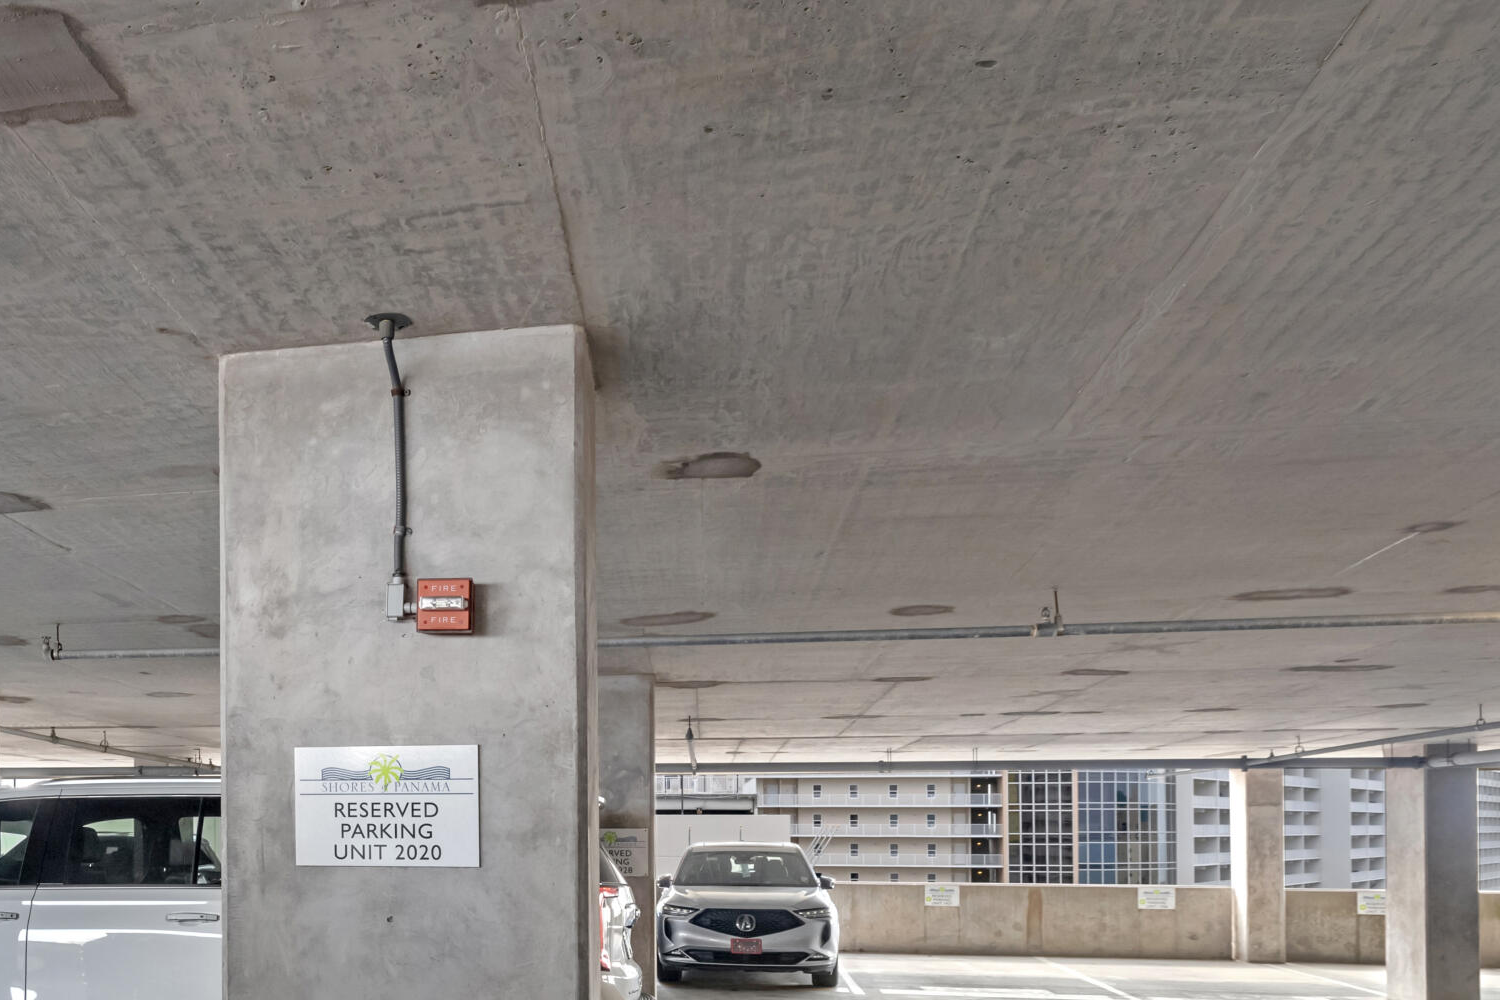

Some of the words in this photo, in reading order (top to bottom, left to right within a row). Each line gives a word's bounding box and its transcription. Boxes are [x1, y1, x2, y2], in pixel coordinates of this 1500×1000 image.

[321, 782, 375, 793] SHORES
[394, 781, 451, 793] PANAMA
[334, 802, 439, 818] RESERVED
[341, 823, 433, 839] PARKING
[334, 844, 388, 860] UNIT
[395, 844, 442, 861] 2020
[608, 849, 632, 857] RVED
